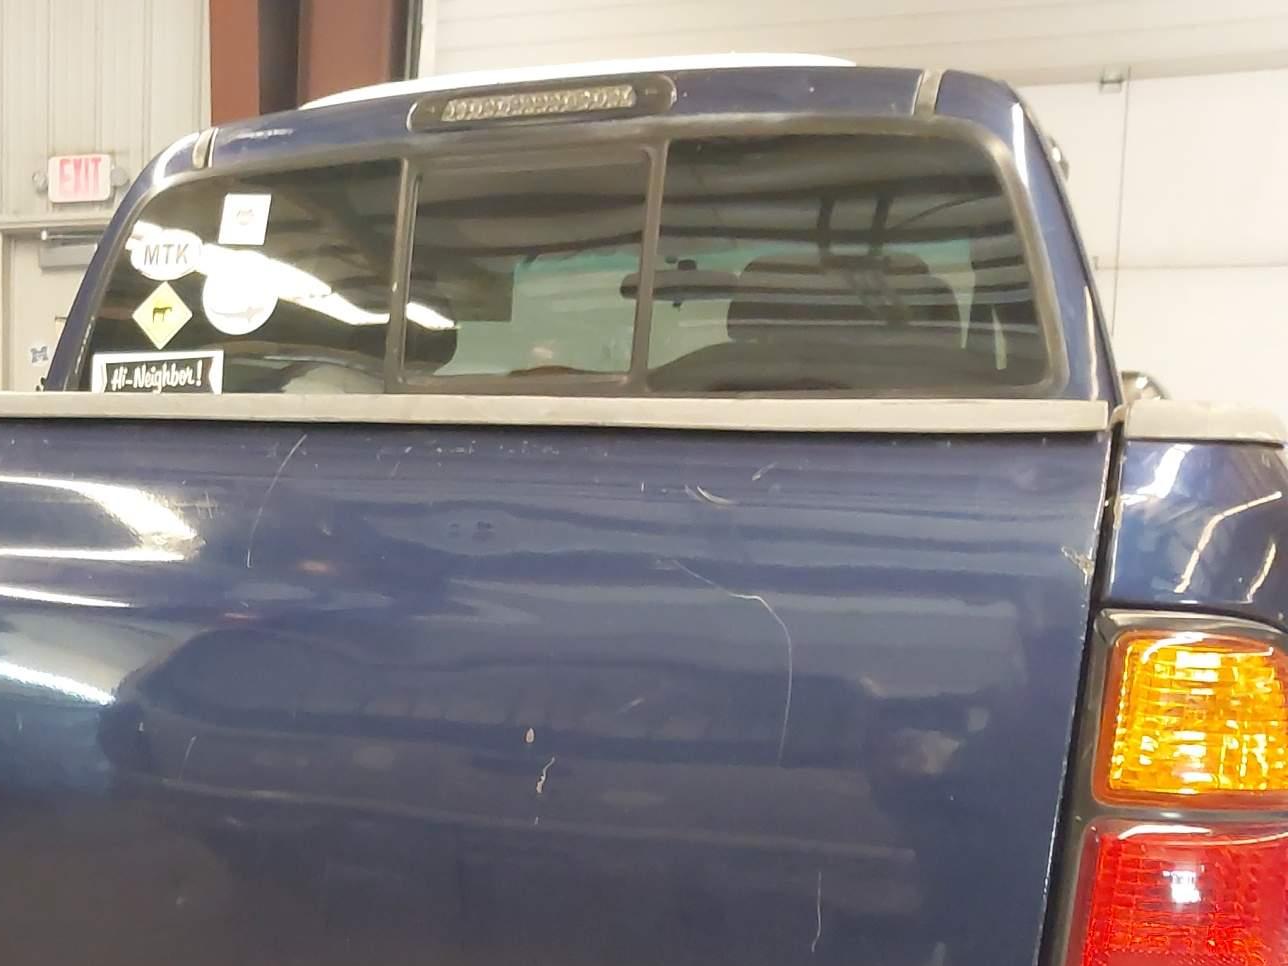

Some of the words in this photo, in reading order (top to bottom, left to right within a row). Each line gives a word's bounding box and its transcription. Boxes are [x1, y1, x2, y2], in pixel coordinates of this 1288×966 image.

[58, 156, 103, 196] EXIT
[143, 242, 190, 267] MTK
[110, 359, 203, 394] Hi-Neighbor!
